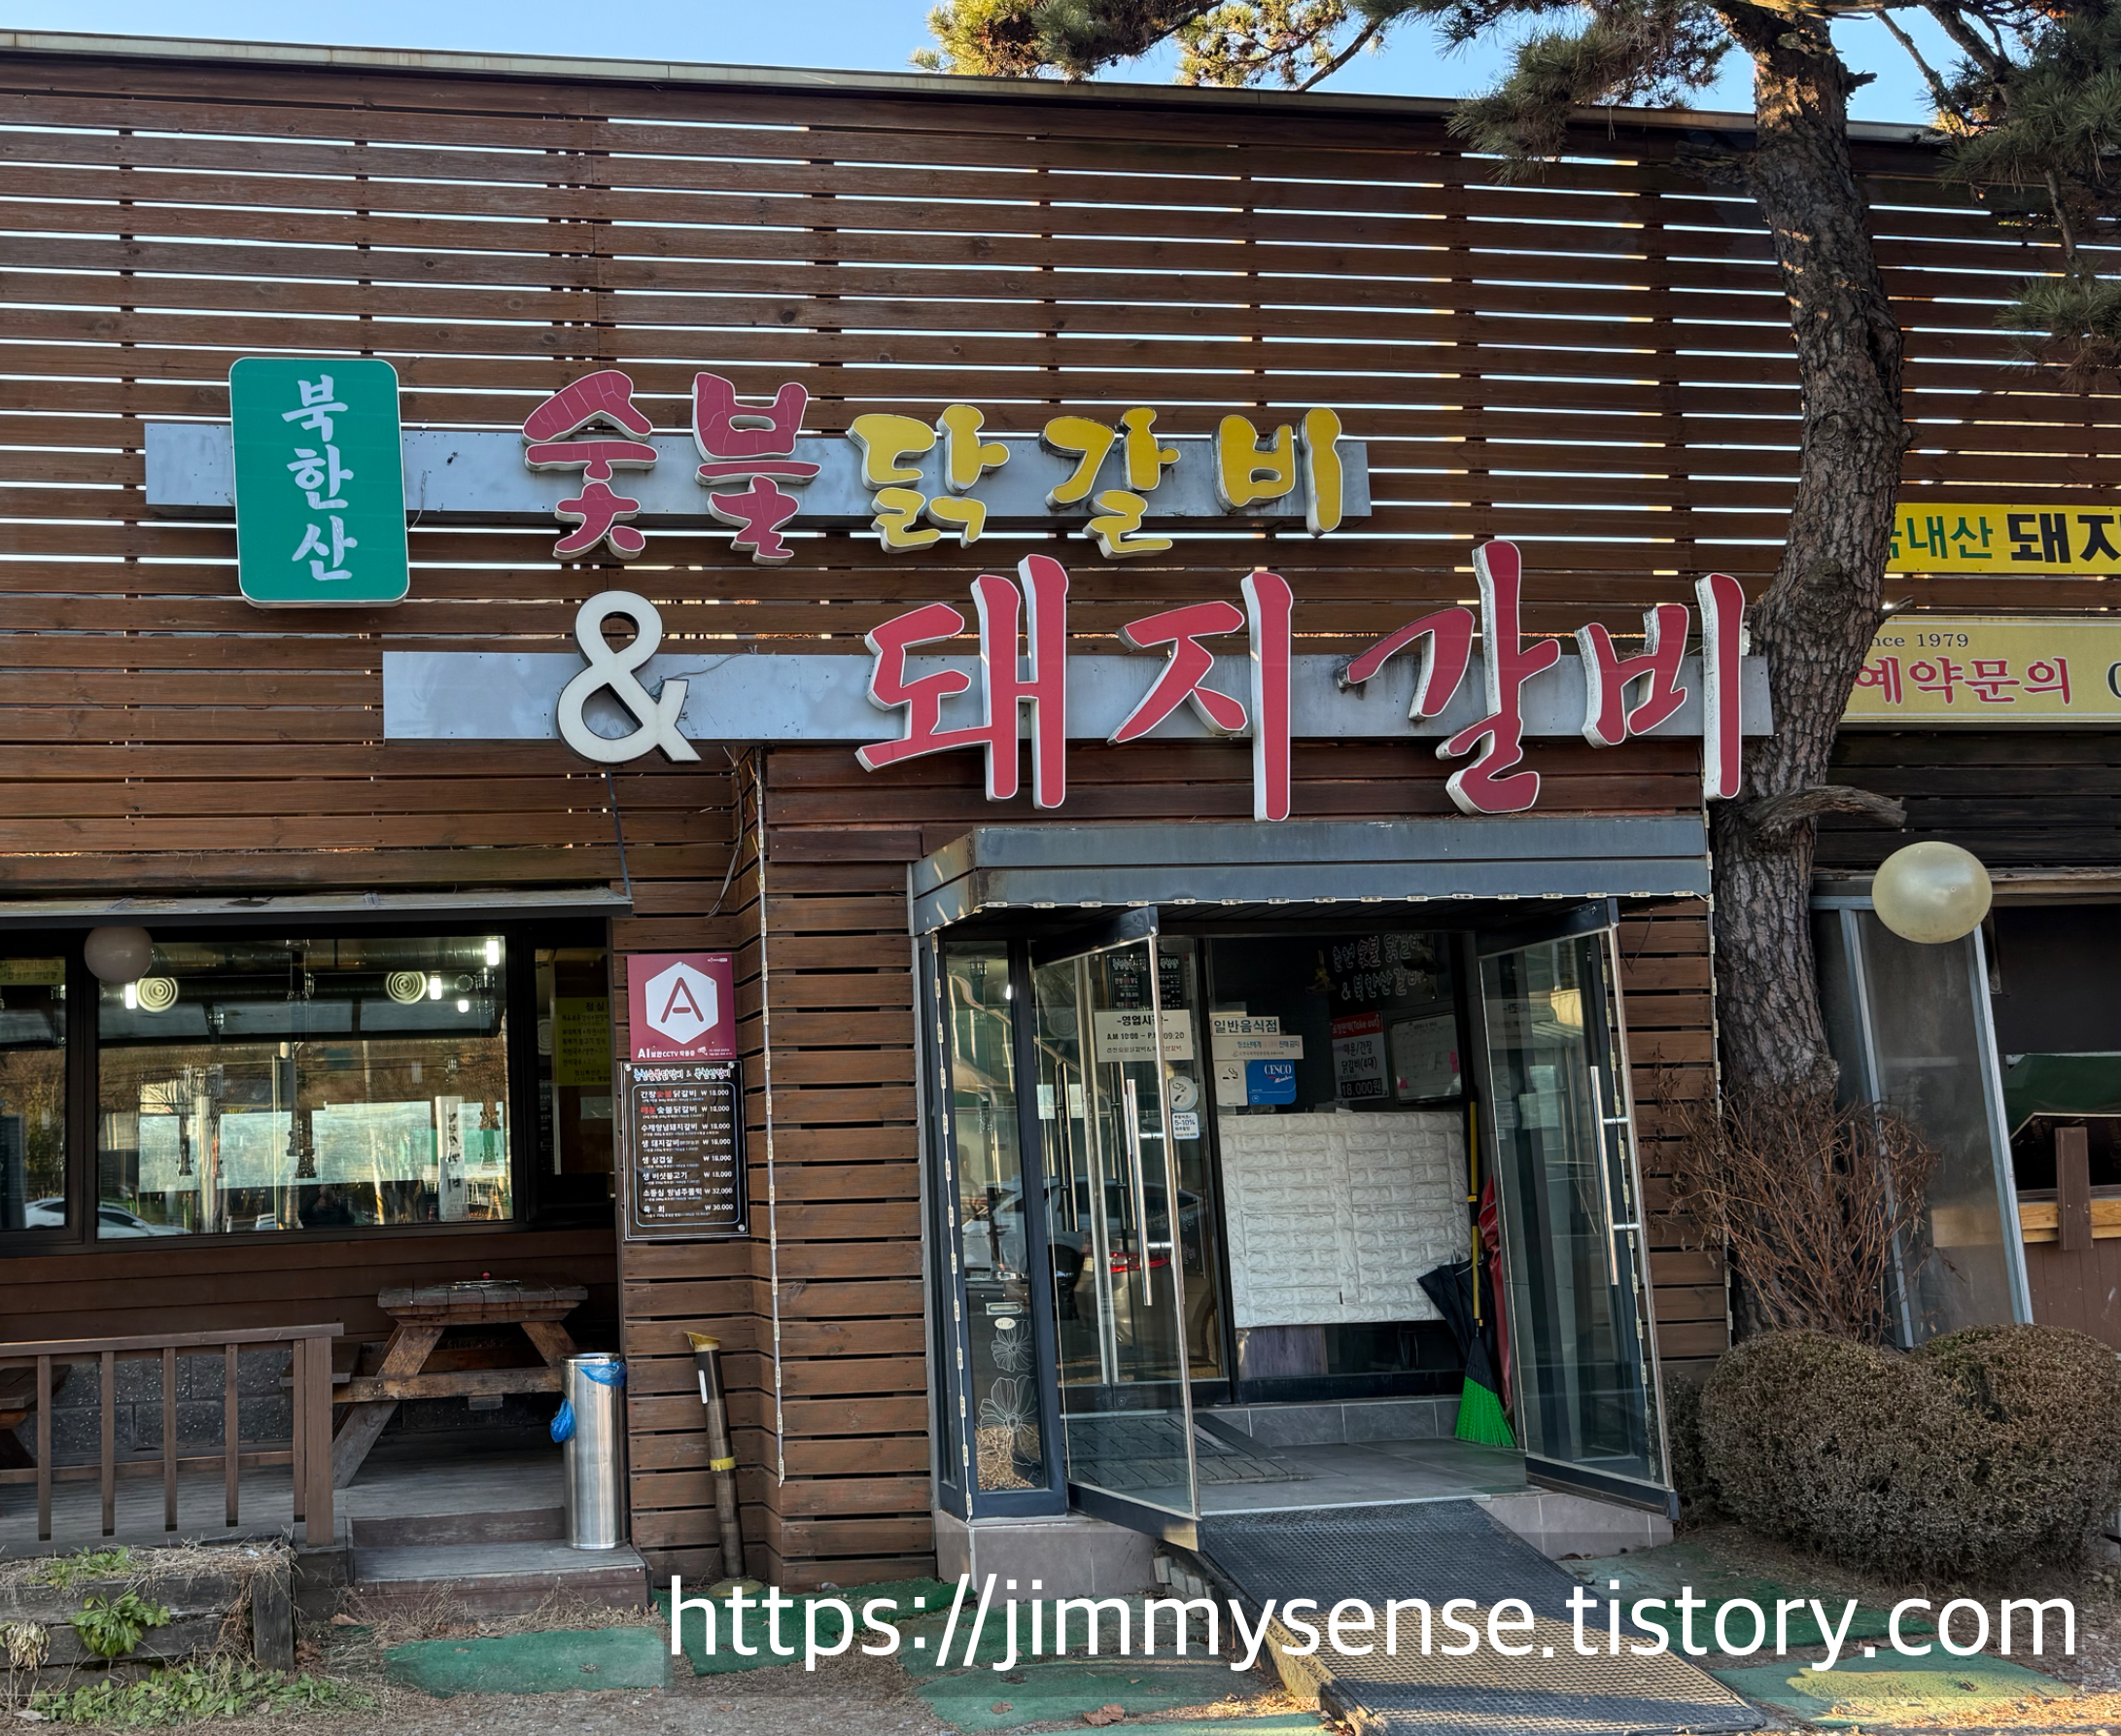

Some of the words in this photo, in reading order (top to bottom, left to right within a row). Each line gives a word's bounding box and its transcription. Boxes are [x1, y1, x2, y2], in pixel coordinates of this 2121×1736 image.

[282, 373, 358, 581] 북한산
[1917, 633, 1969, 648] 1979
[855, 538, 1746, 821] 돼지갈비
[1855, 655, 2072, 706] 예약문의
[1214, 1019, 1278, 1034] 일반음식점
[1264, 1063, 1292, 1075] CESCO
